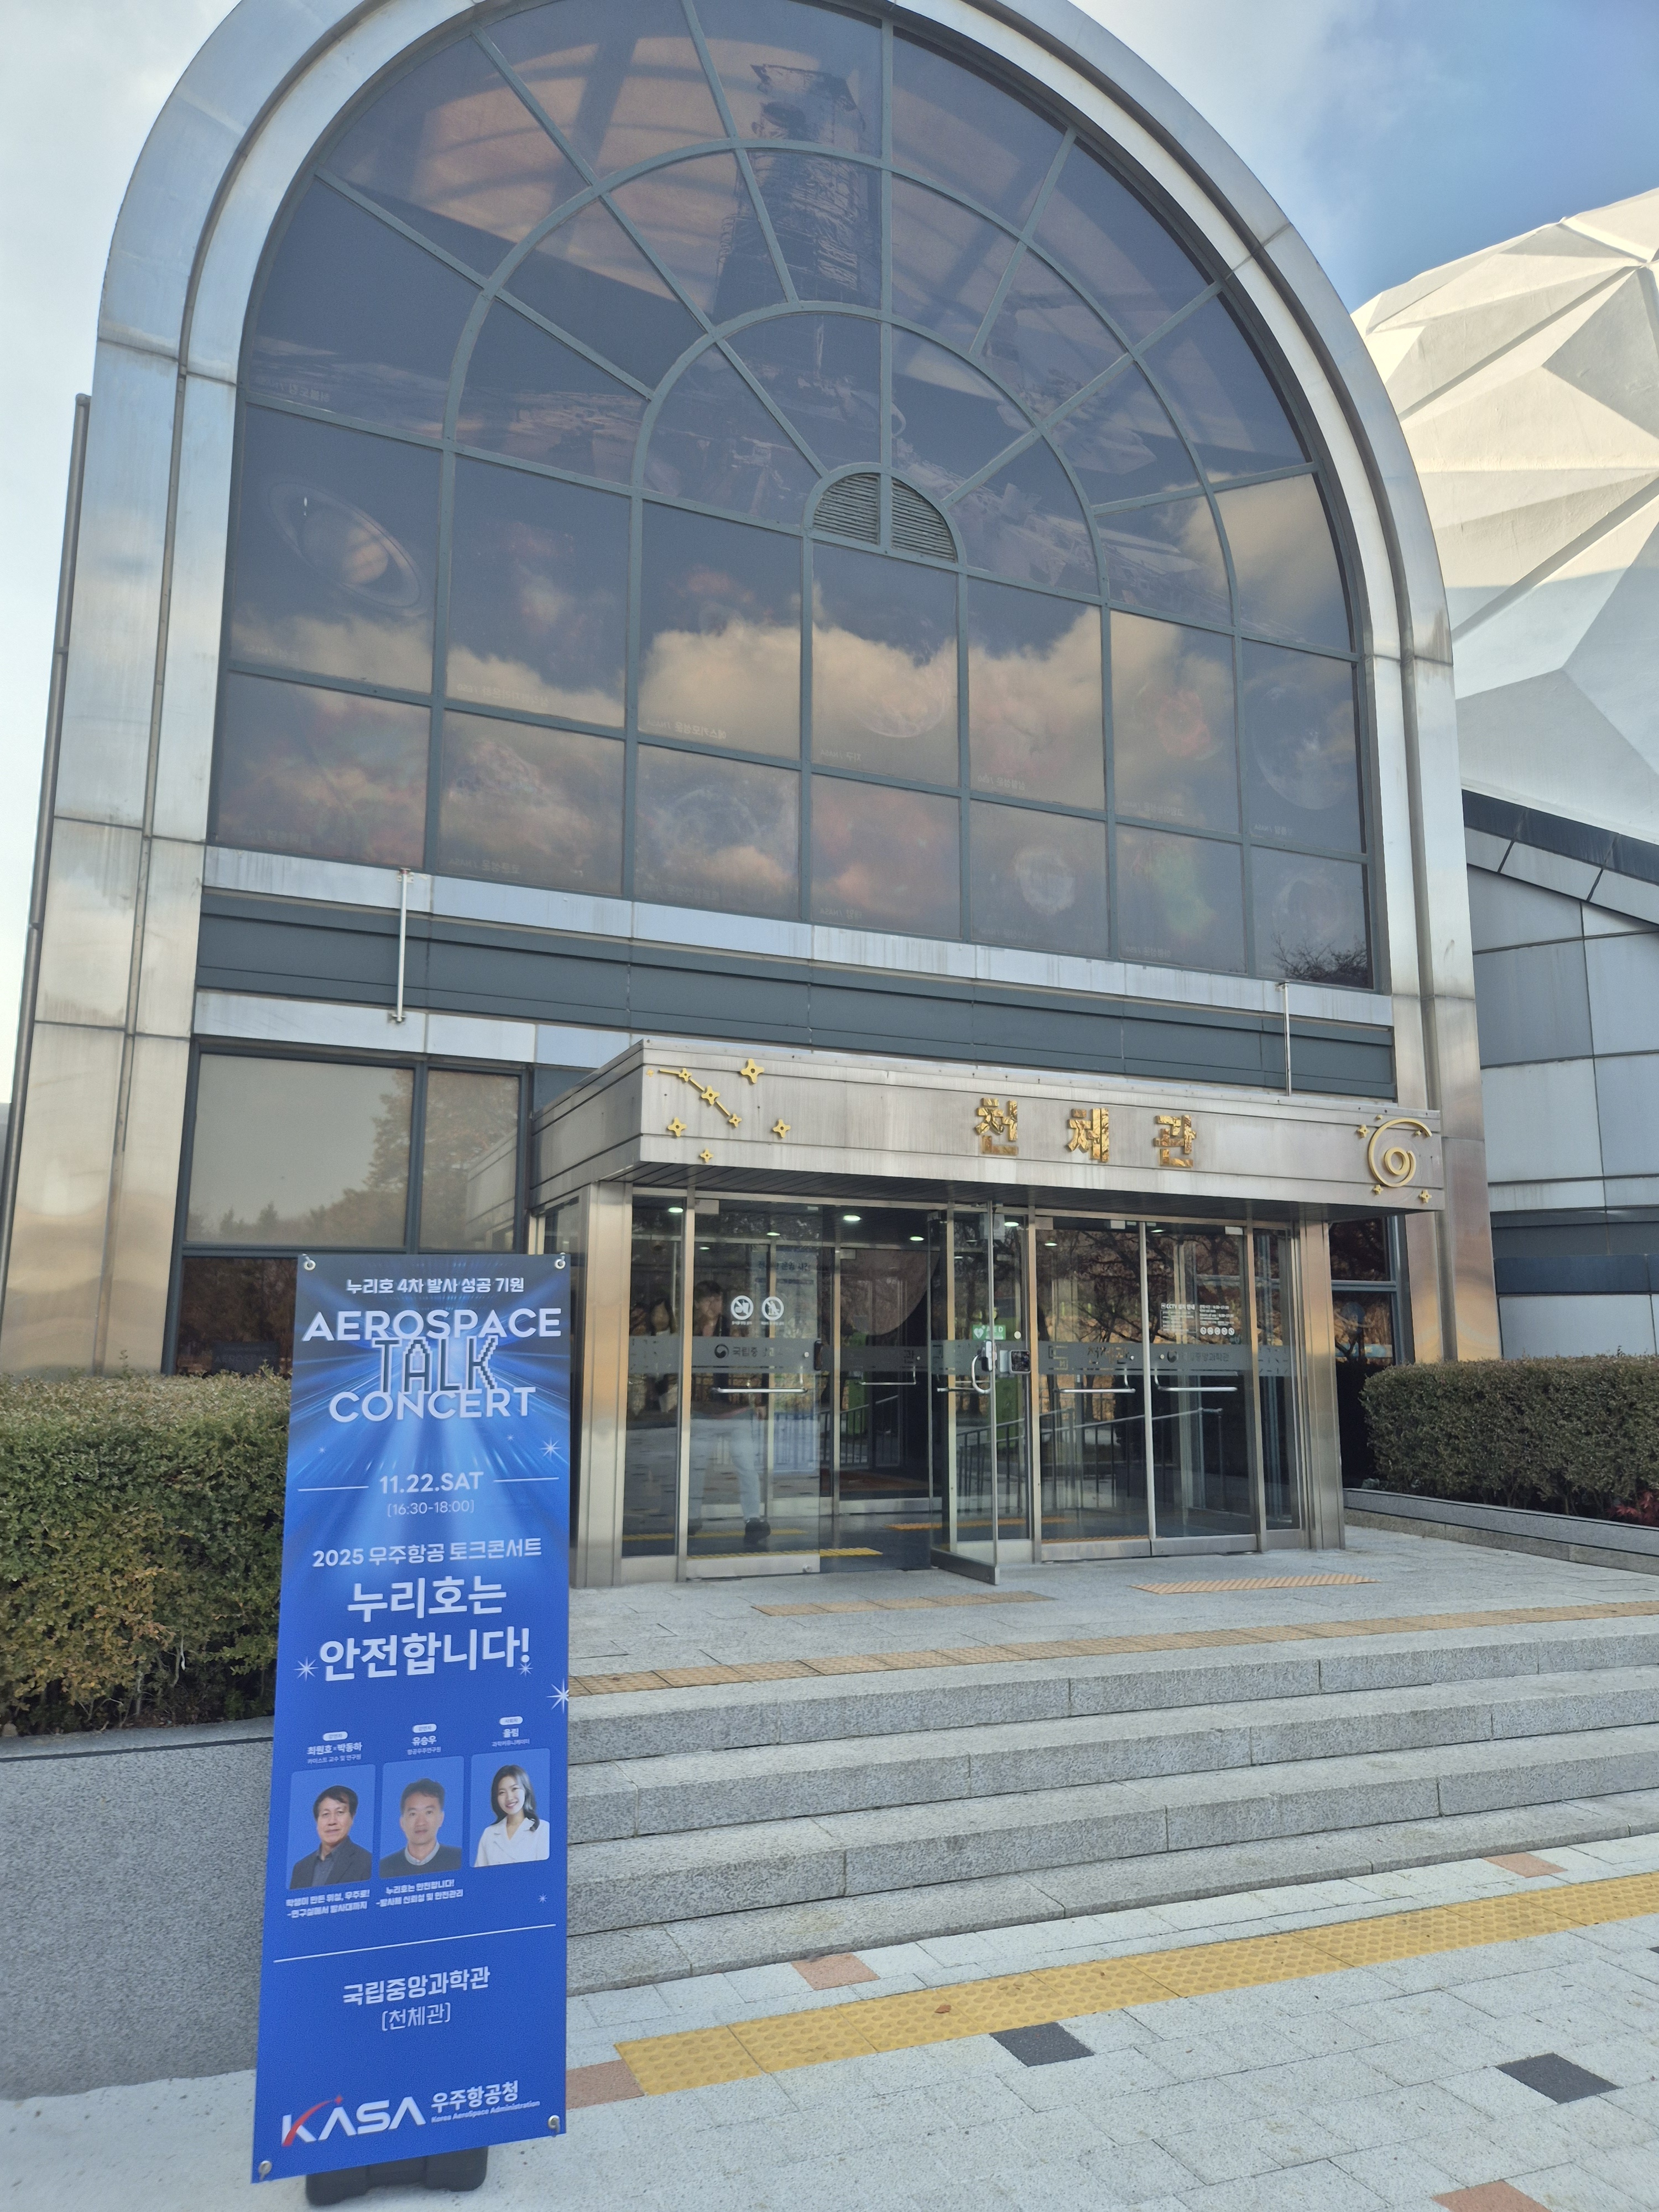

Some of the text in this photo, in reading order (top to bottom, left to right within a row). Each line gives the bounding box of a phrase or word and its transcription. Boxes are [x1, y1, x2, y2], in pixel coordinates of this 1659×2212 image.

[346, 1277, 524, 1294] 누리호 4차 발사 성공 기원
[302, 1308, 562, 1342] AEROSPACE
[372, 1335, 499, 1394] TALK
[330, 1387, 536, 1422] CONCERT
[379, 1472, 484, 1494] 11.22.SAT
[312, 1538, 542, 1567] 2025 우주항공 토크콘서트
[347, 1575, 507, 1623] 누리호는
[320, 1626, 530, 1682] 안전합니다!
[407, 1746, 441, 1755] 항공우주연구원
[411, 1735, 437, 1746] 유승우
[385, 1879, 455, 1895] 누리호는 안전합니다!
[403, 1893, 425, 1904] 신뢰성
[426, 1892, 434, 1901] 및
[434, 1889, 463, 1900] 안전관리
[286, 1897, 309, 1907] 학생이
[310, 1895, 325, 1904] 만든
[330, 1901, 368, 1913] 발사대까지
[342, 1966, 491, 2005] 국립중앙과학관
[431, 2080, 518, 2113] 우주항공청
[281, 2095, 426, 2147] KASA
[431, 2115, 452, 2123] Korea
[490, 2100, 540, 2114] Administration
